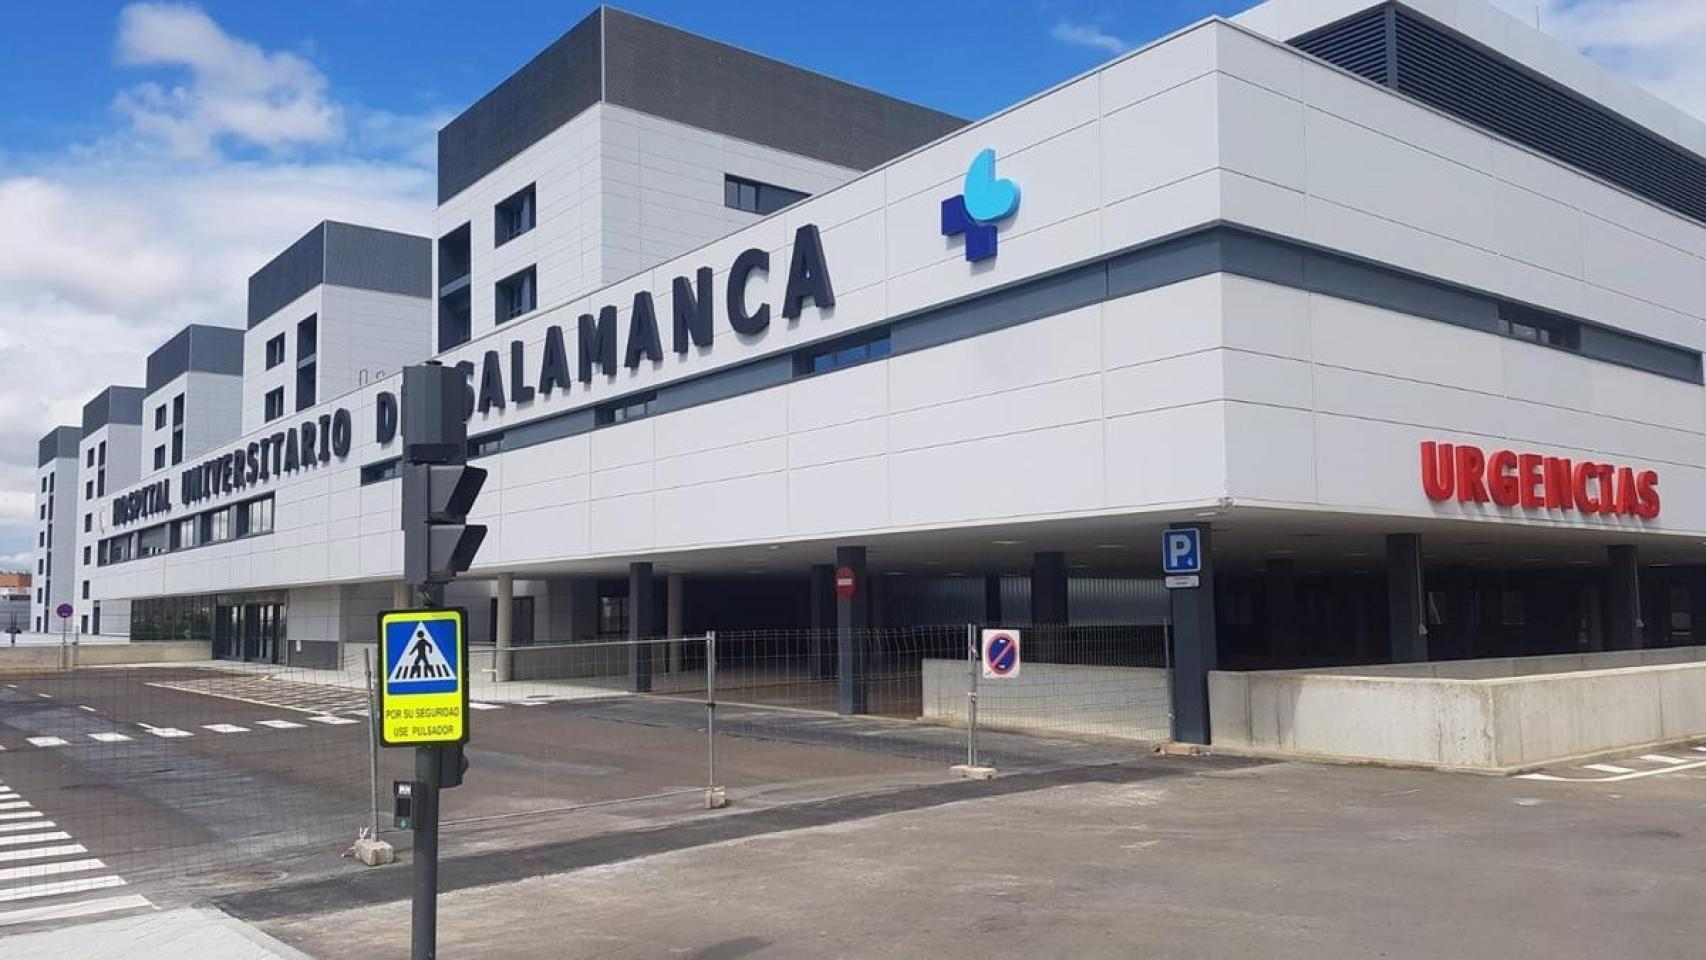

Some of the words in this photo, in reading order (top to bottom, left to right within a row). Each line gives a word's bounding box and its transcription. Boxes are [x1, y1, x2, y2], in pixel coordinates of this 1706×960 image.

[112, 478, 171, 526] HOSPITAL
[181, 407, 352, 506] UNIVERSITARIO
[1420, 441, 1660, 519] URGENCIAS
[1169, 534, 1191, 567] P
[386, 709, 401, 719] POR
[403, 708, 414, 718] SU
[416, 706, 460, 718] SEGURIDAD
[393, 726, 408, 737] USE
[411, 724, 454, 735] PULSADOR
